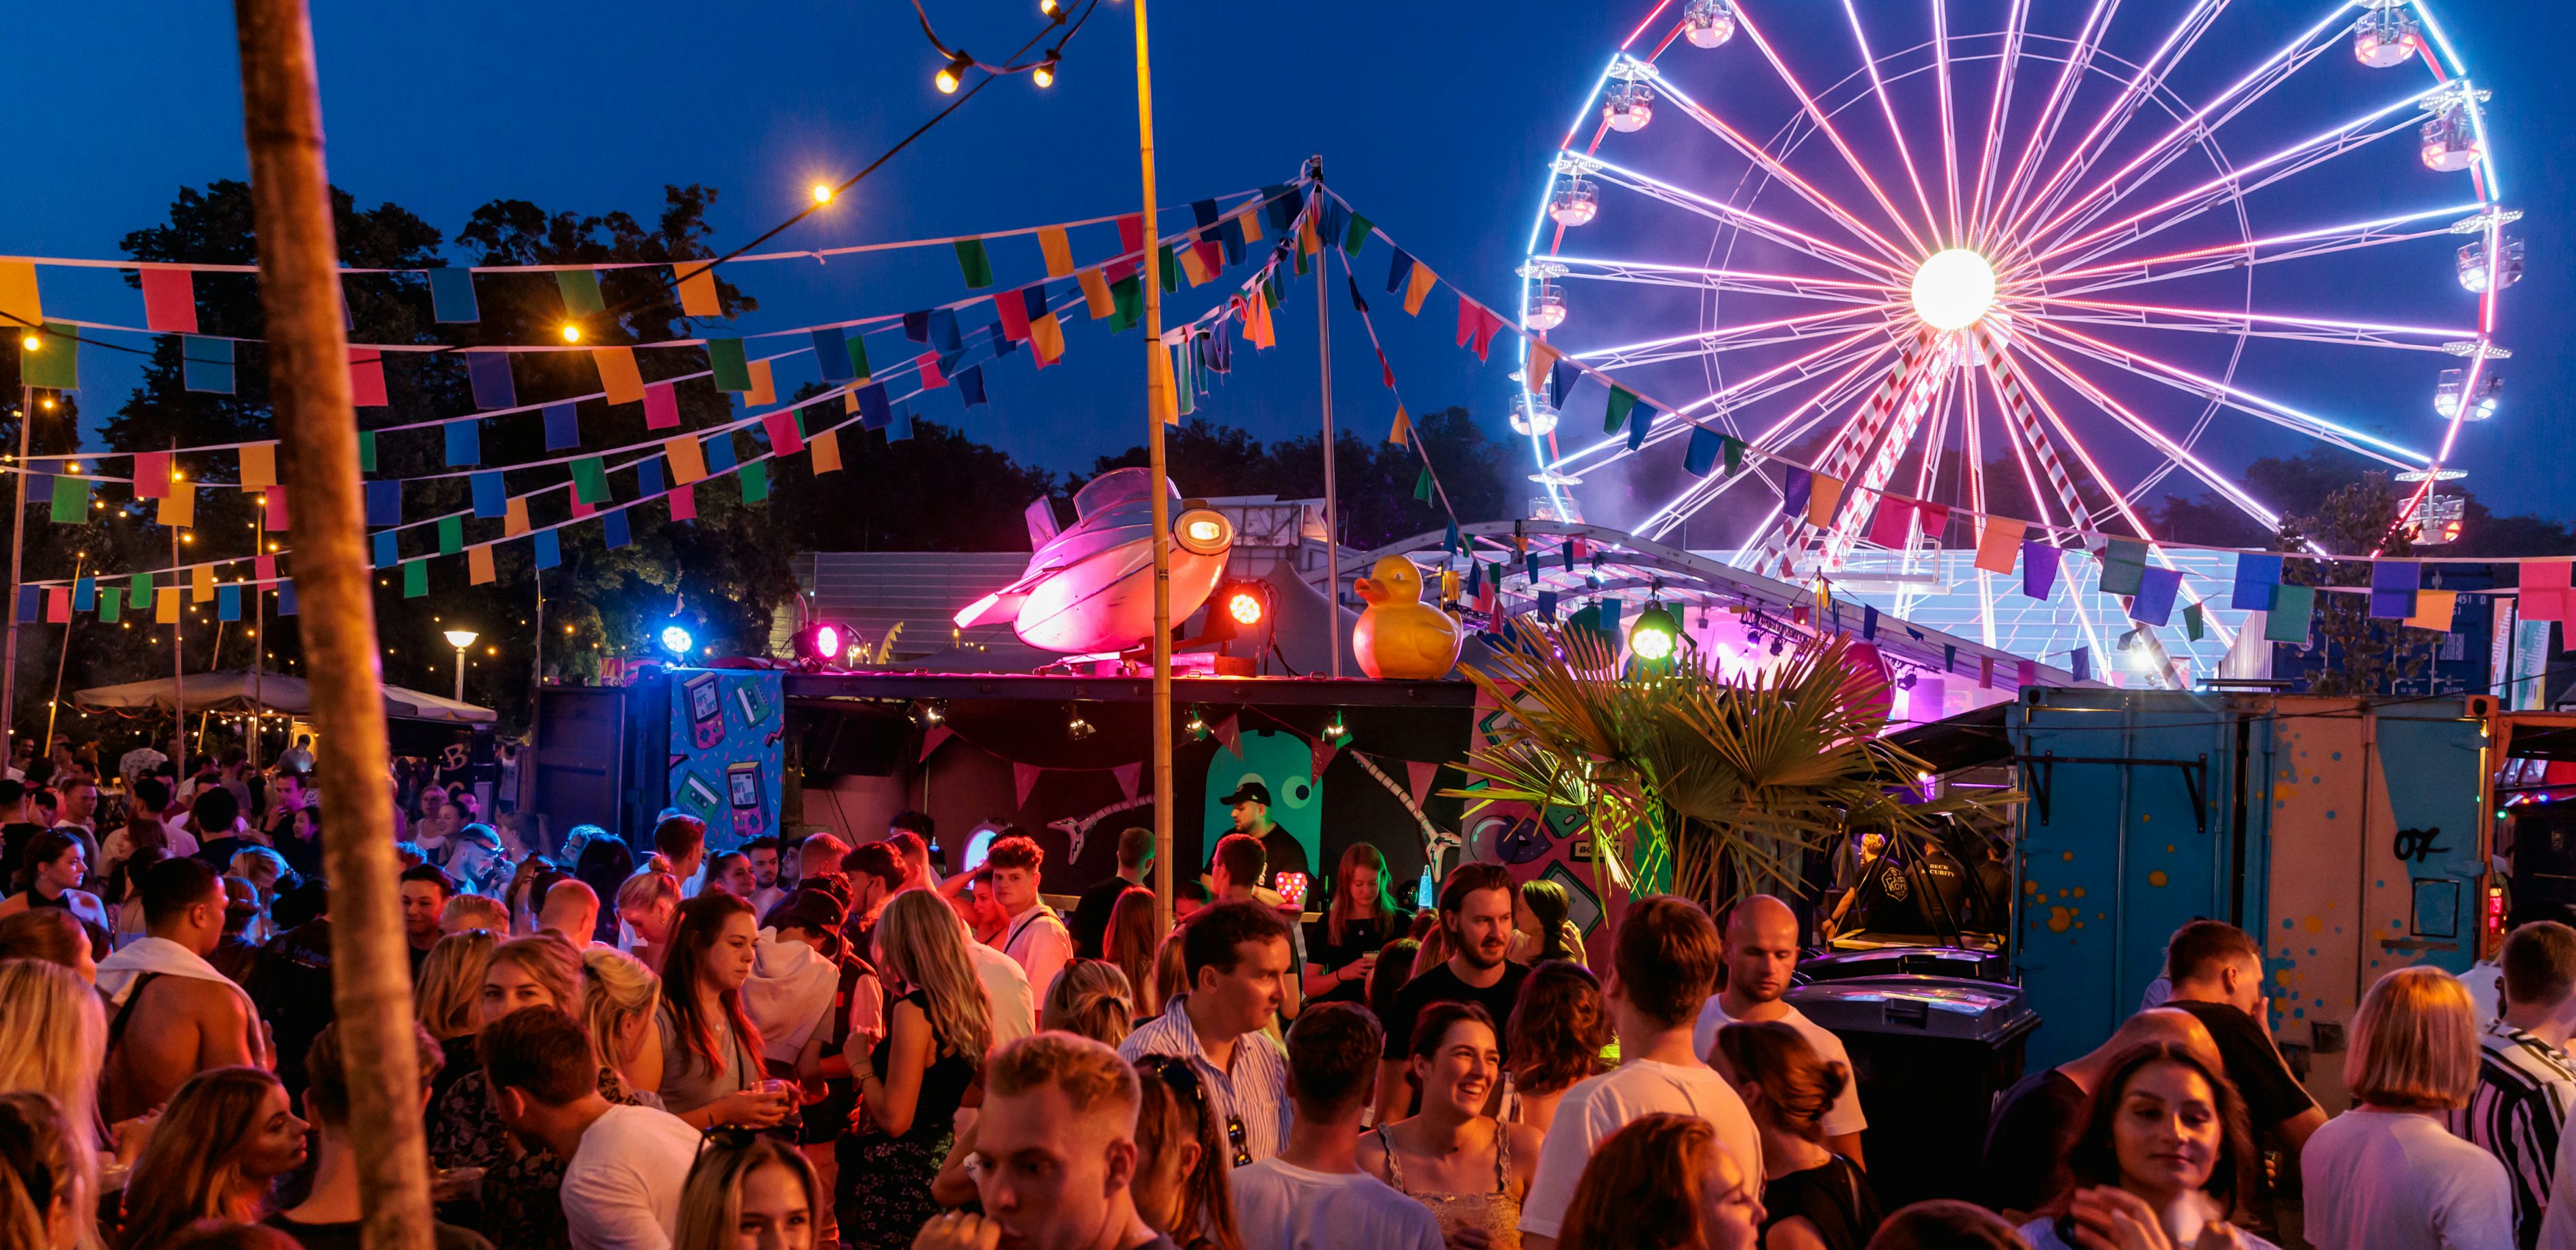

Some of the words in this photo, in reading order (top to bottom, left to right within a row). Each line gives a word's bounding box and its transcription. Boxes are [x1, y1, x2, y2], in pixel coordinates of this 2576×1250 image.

[2491, 606, 2512, 666] collection
[2394, 827, 2452, 864] 07
[1921, 868, 1954, 877] SCURITY
